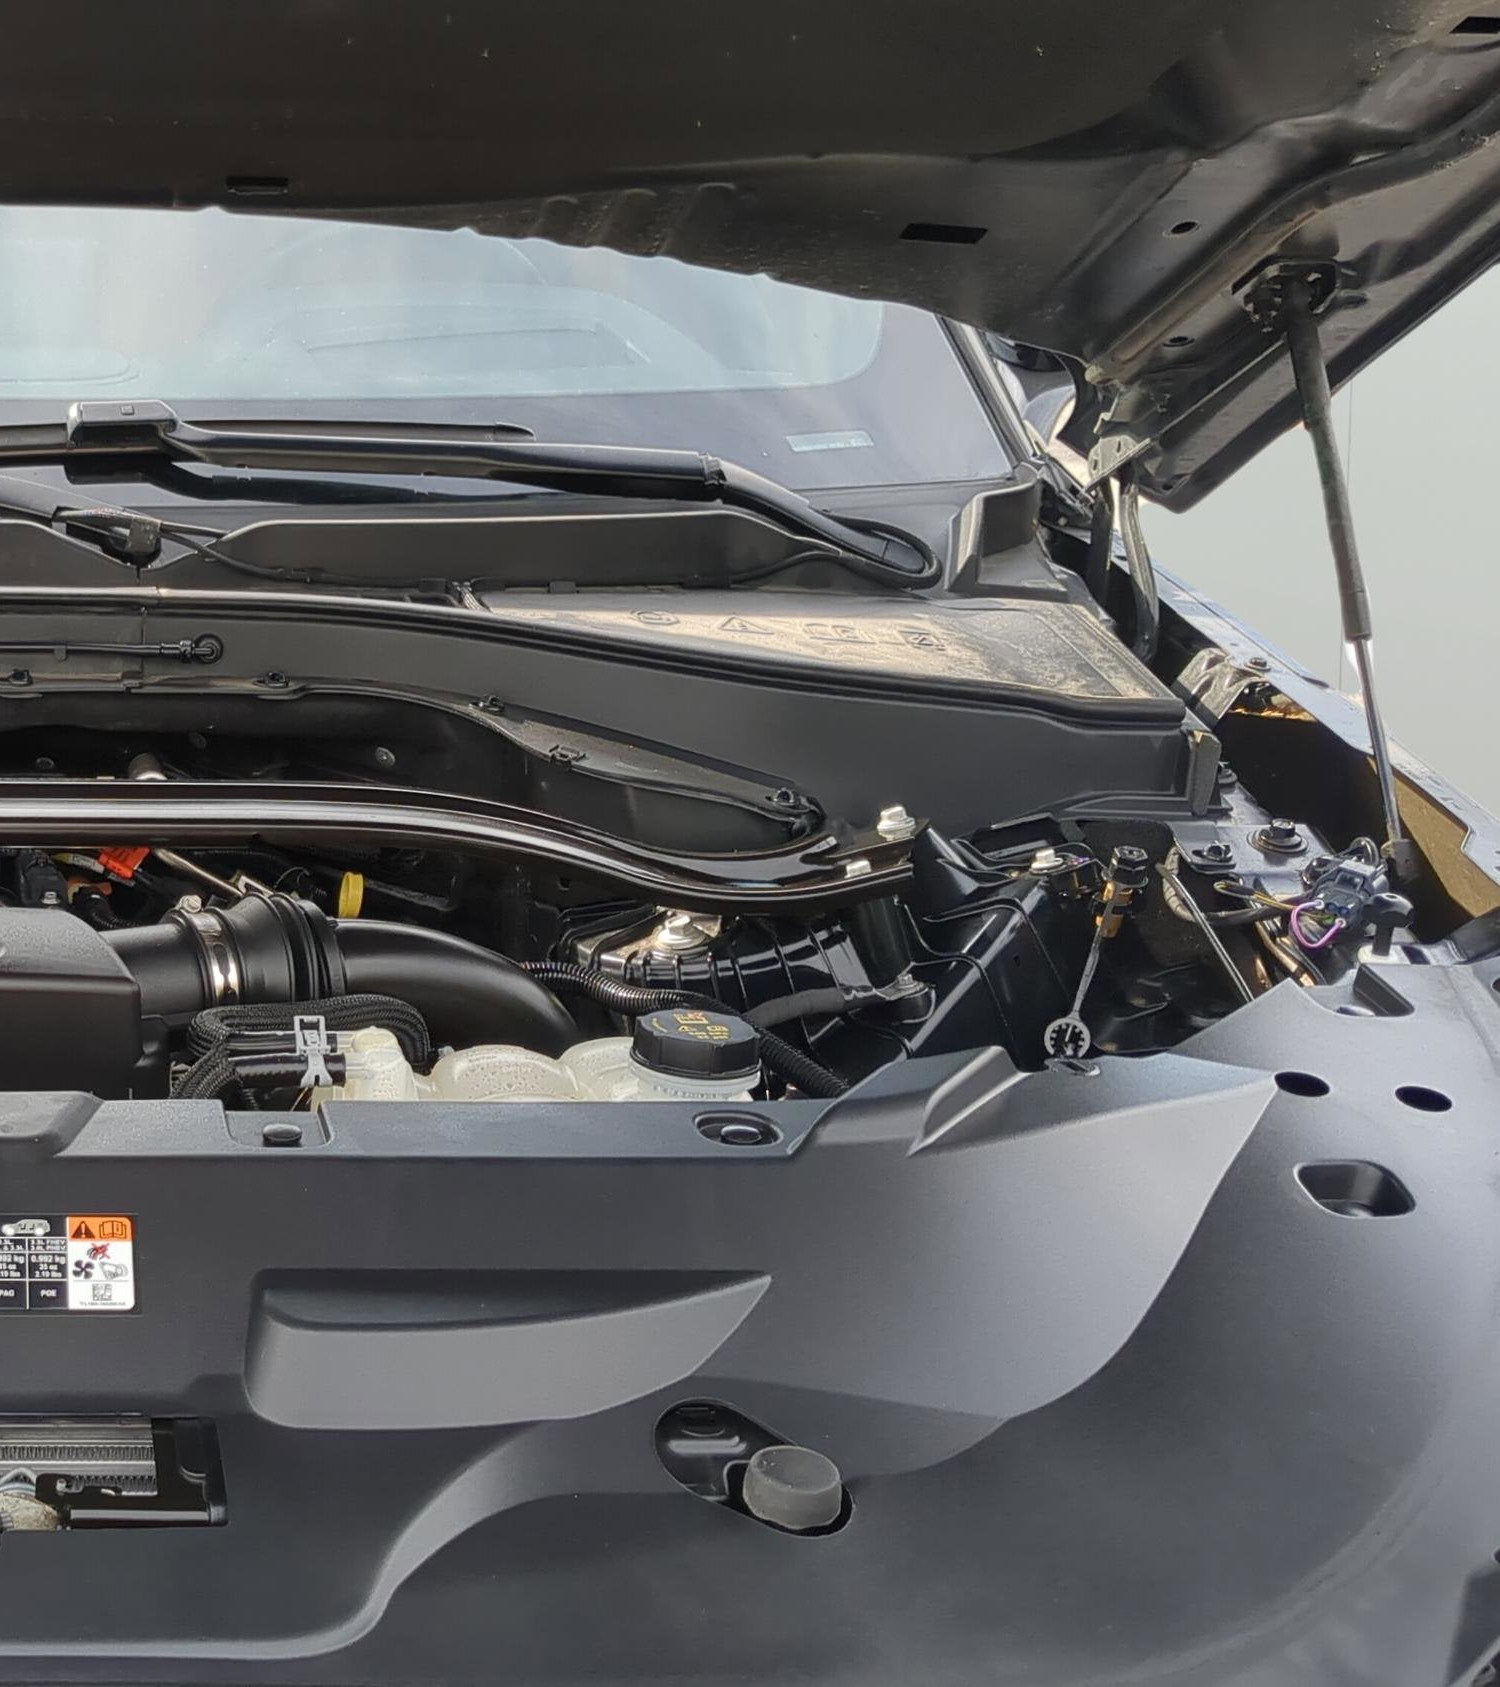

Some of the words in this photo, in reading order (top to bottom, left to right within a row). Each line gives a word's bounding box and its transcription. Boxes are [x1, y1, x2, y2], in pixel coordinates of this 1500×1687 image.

[13, 1254, 25, 1264] kg
[31, 1254, 53, 1262] 0.992
[54, 1255, 66, 1264] kg
[40, 1289, 57, 1297] POE
